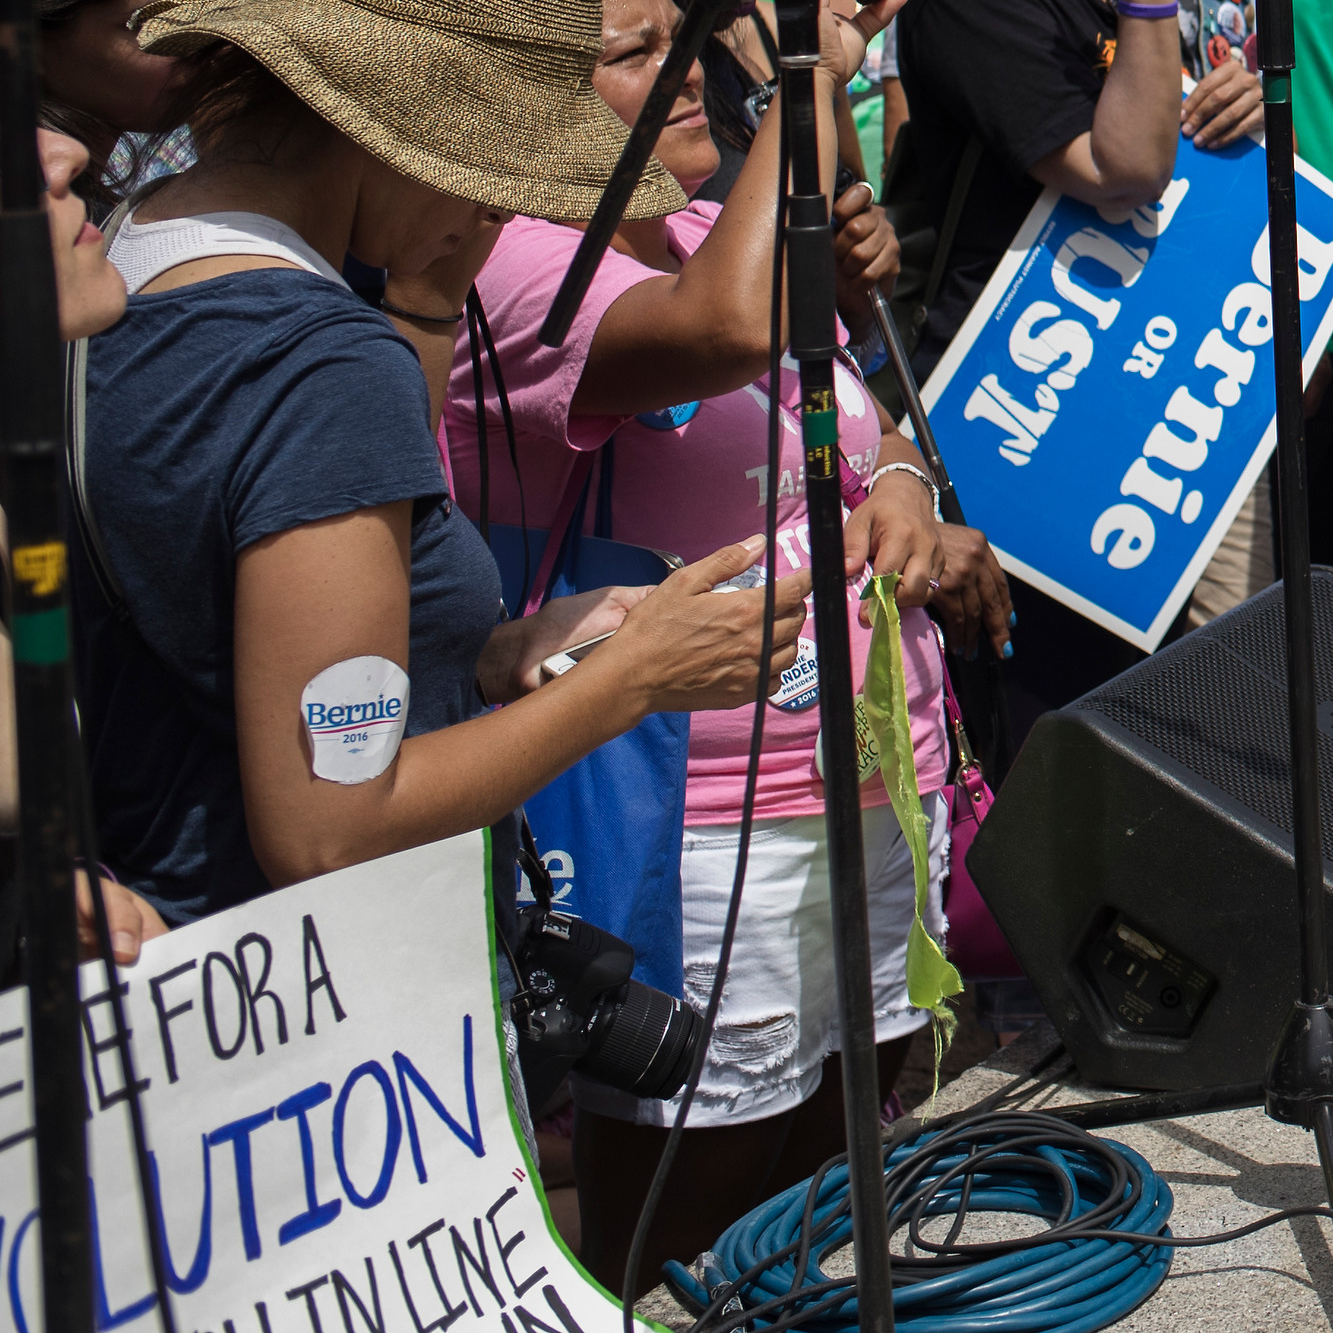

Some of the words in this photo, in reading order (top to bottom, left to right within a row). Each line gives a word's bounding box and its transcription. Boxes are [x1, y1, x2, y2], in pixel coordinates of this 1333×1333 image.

[1123, 315, 1178, 379] OR
[306, 694, 402, 727] Bernie
[797, 690, 817, 705] 2016
[343, 732, 369, 744] 2016
[148, 932, 289, 1085] FOR
[302, 914, 347, 1036] A
